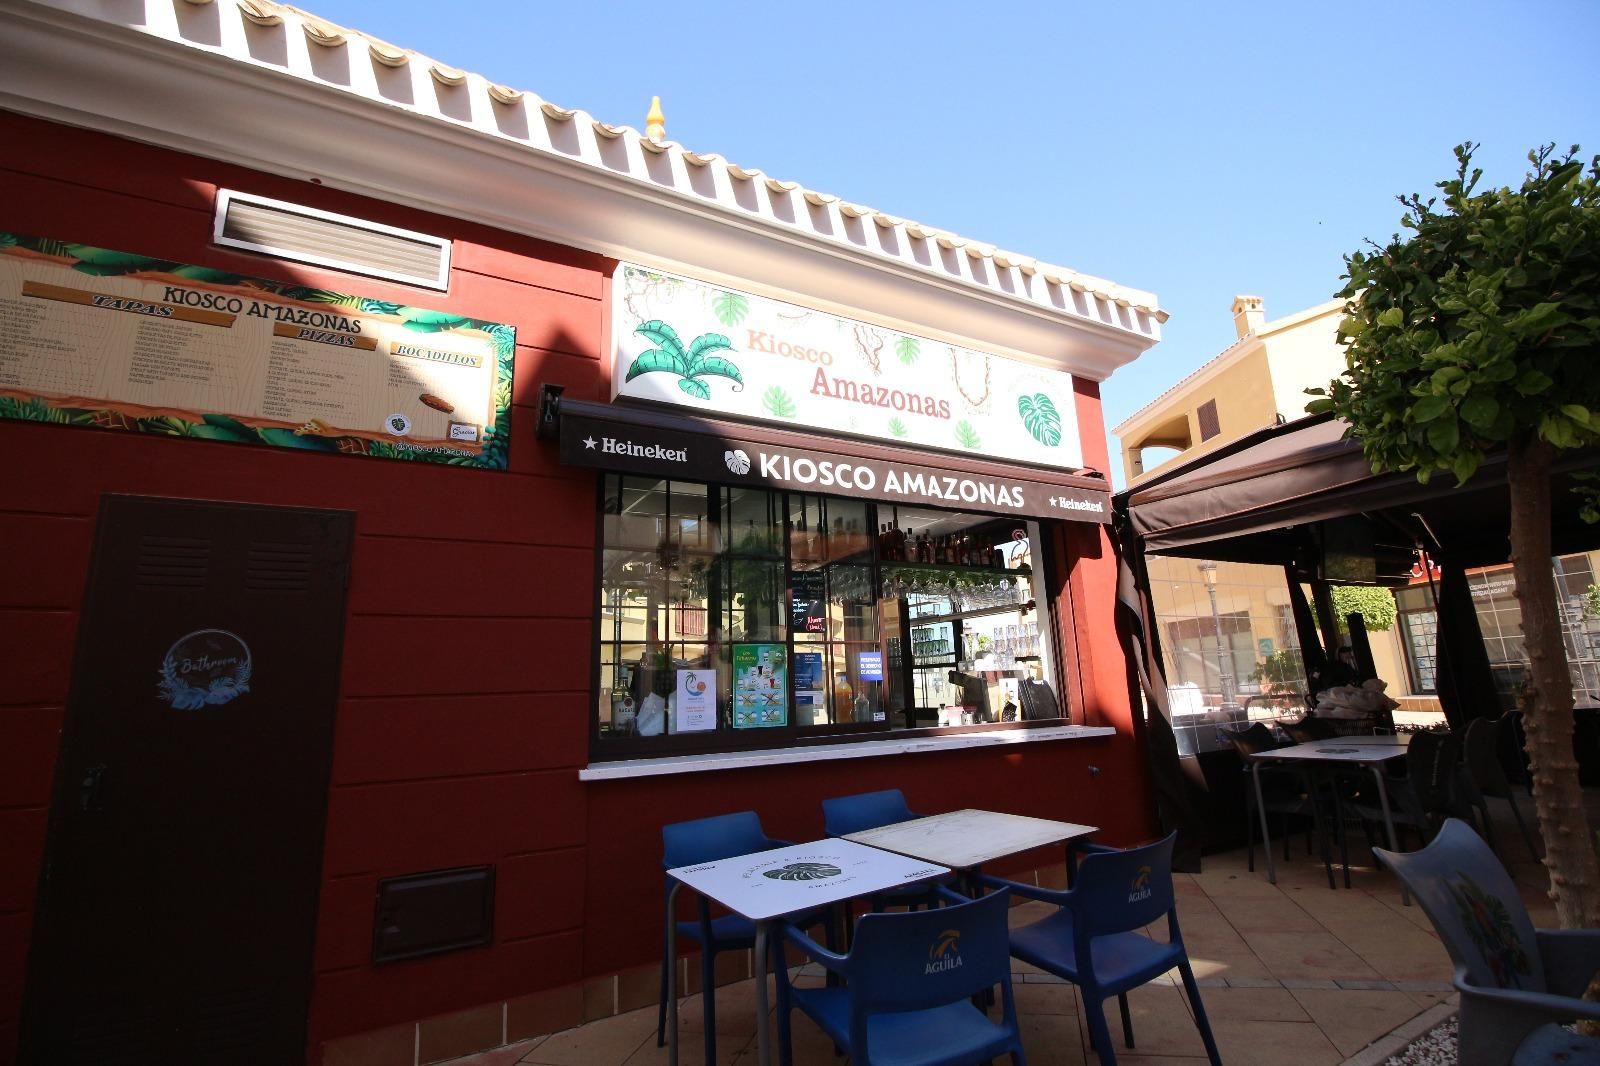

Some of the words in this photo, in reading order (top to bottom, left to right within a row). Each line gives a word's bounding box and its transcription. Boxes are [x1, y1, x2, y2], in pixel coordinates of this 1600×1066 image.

[92, 295, 174, 316] TAPAS
[163, 286, 242, 314] KIOSCO
[247, 301, 361, 334] AMAZONAS
[297, 328, 357, 347] PIZZAS
[746, 329, 833, 366] Kiosco
[397, 345, 477, 367] BOCADILLOS
[810, 366, 951, 420] Amazonas
[601, 437, 687, 462] Heineken
[759, 453, 876, 491] KIOSCO
[883, 470, 1025, 508] AMAZONAS
[1059, 496, 1104, 513] Heineken
